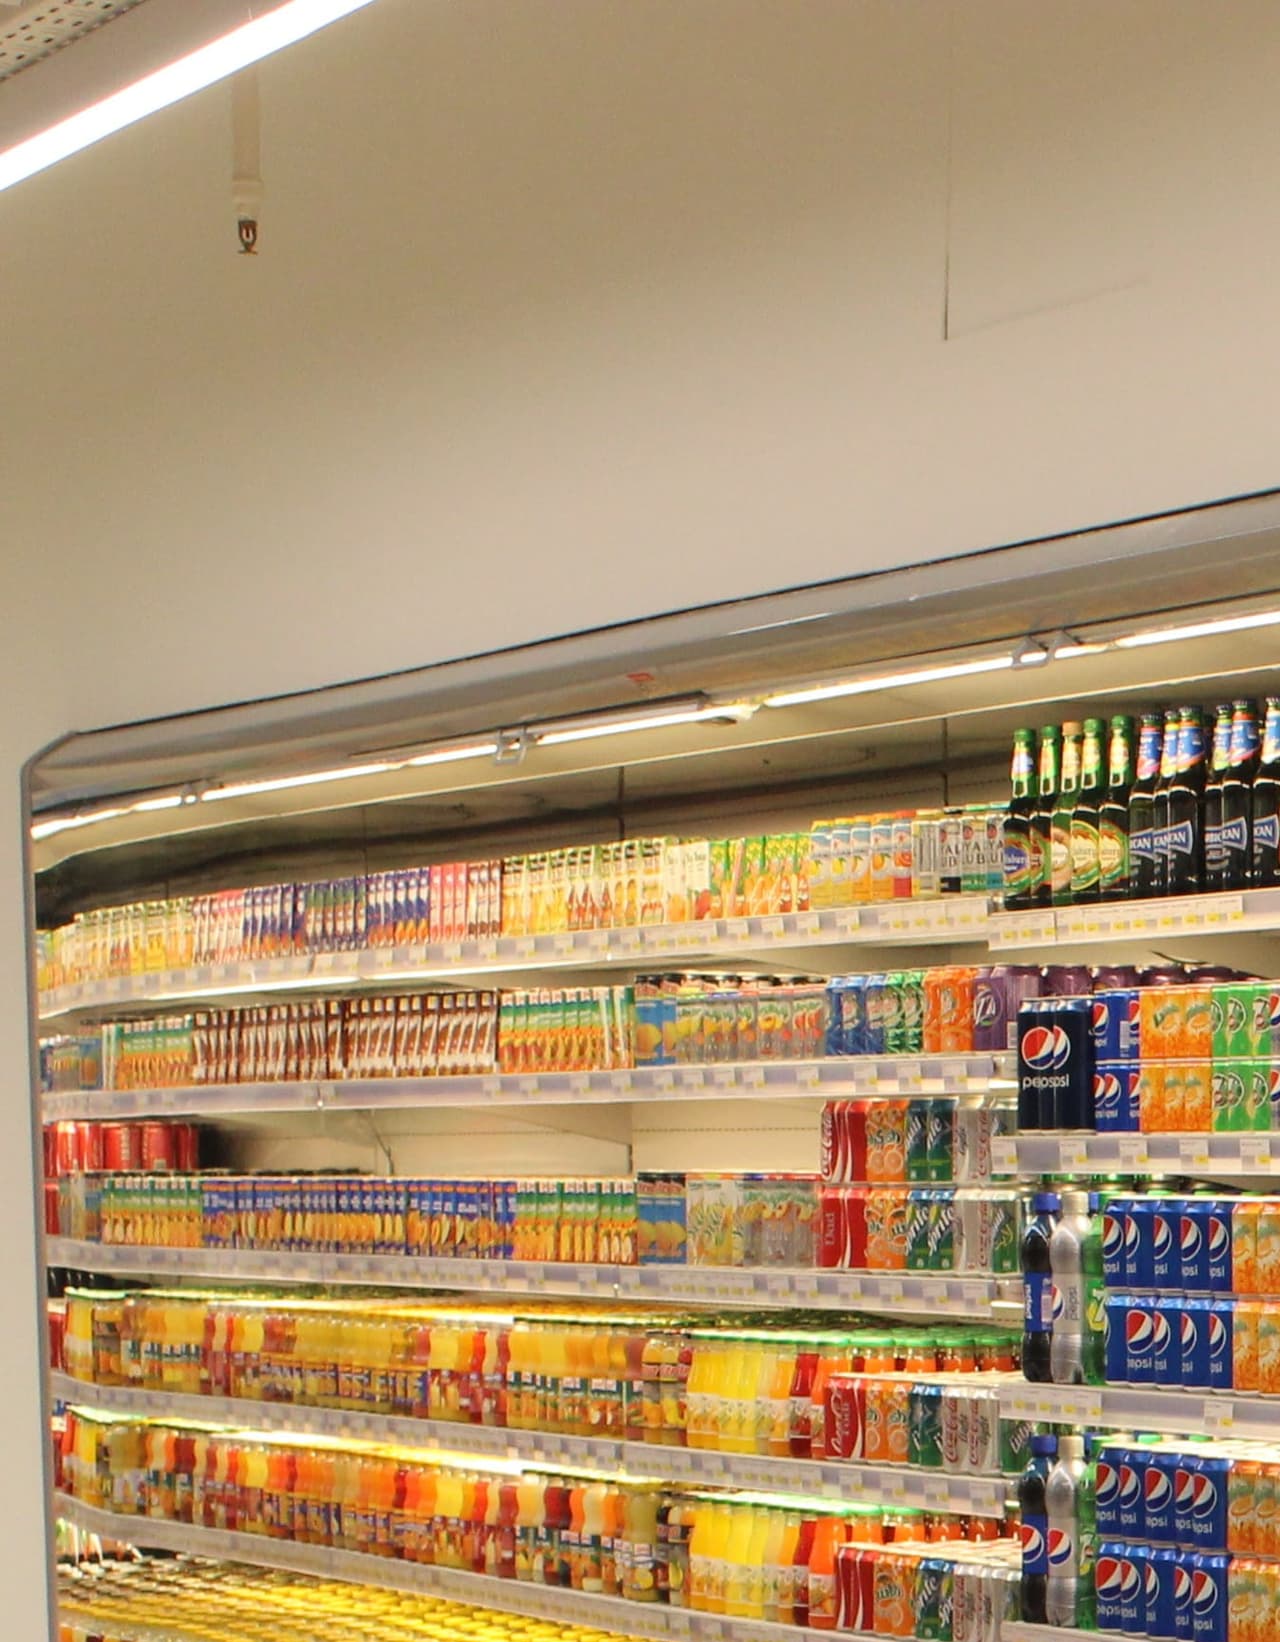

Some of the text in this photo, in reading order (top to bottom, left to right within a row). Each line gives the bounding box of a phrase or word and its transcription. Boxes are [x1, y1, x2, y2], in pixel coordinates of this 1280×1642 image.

[1183, 1264, 1198, 1276] psi
[1209, 1265, 1225, 1278] psi
[1126, 1357, 1153, 1371] epsi
